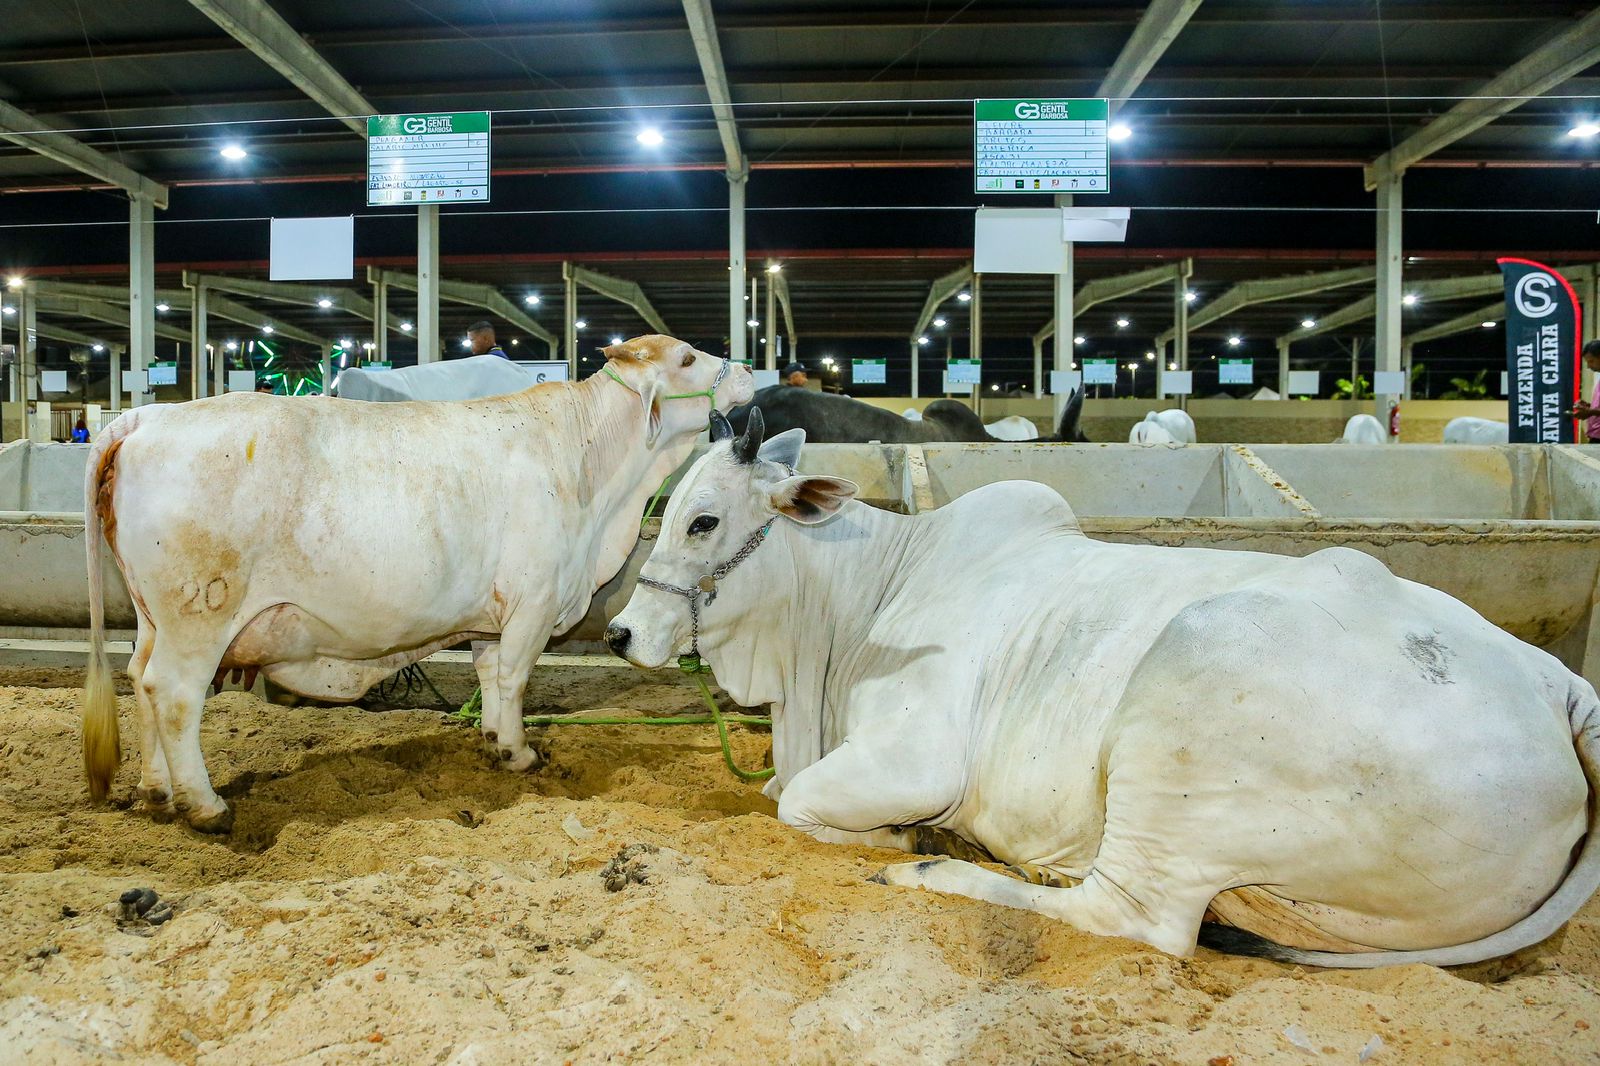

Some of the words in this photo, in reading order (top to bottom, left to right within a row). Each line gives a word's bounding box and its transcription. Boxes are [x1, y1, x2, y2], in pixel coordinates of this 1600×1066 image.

[427, 119, 452, 127] GENTIL
[1041, 105, 1068, 113] GENTIL
[1542, 324, 1559, 385] CLARA
[1517, 343, 1534, 427] FAZENDA
[180, 577, 229, 615] 20
